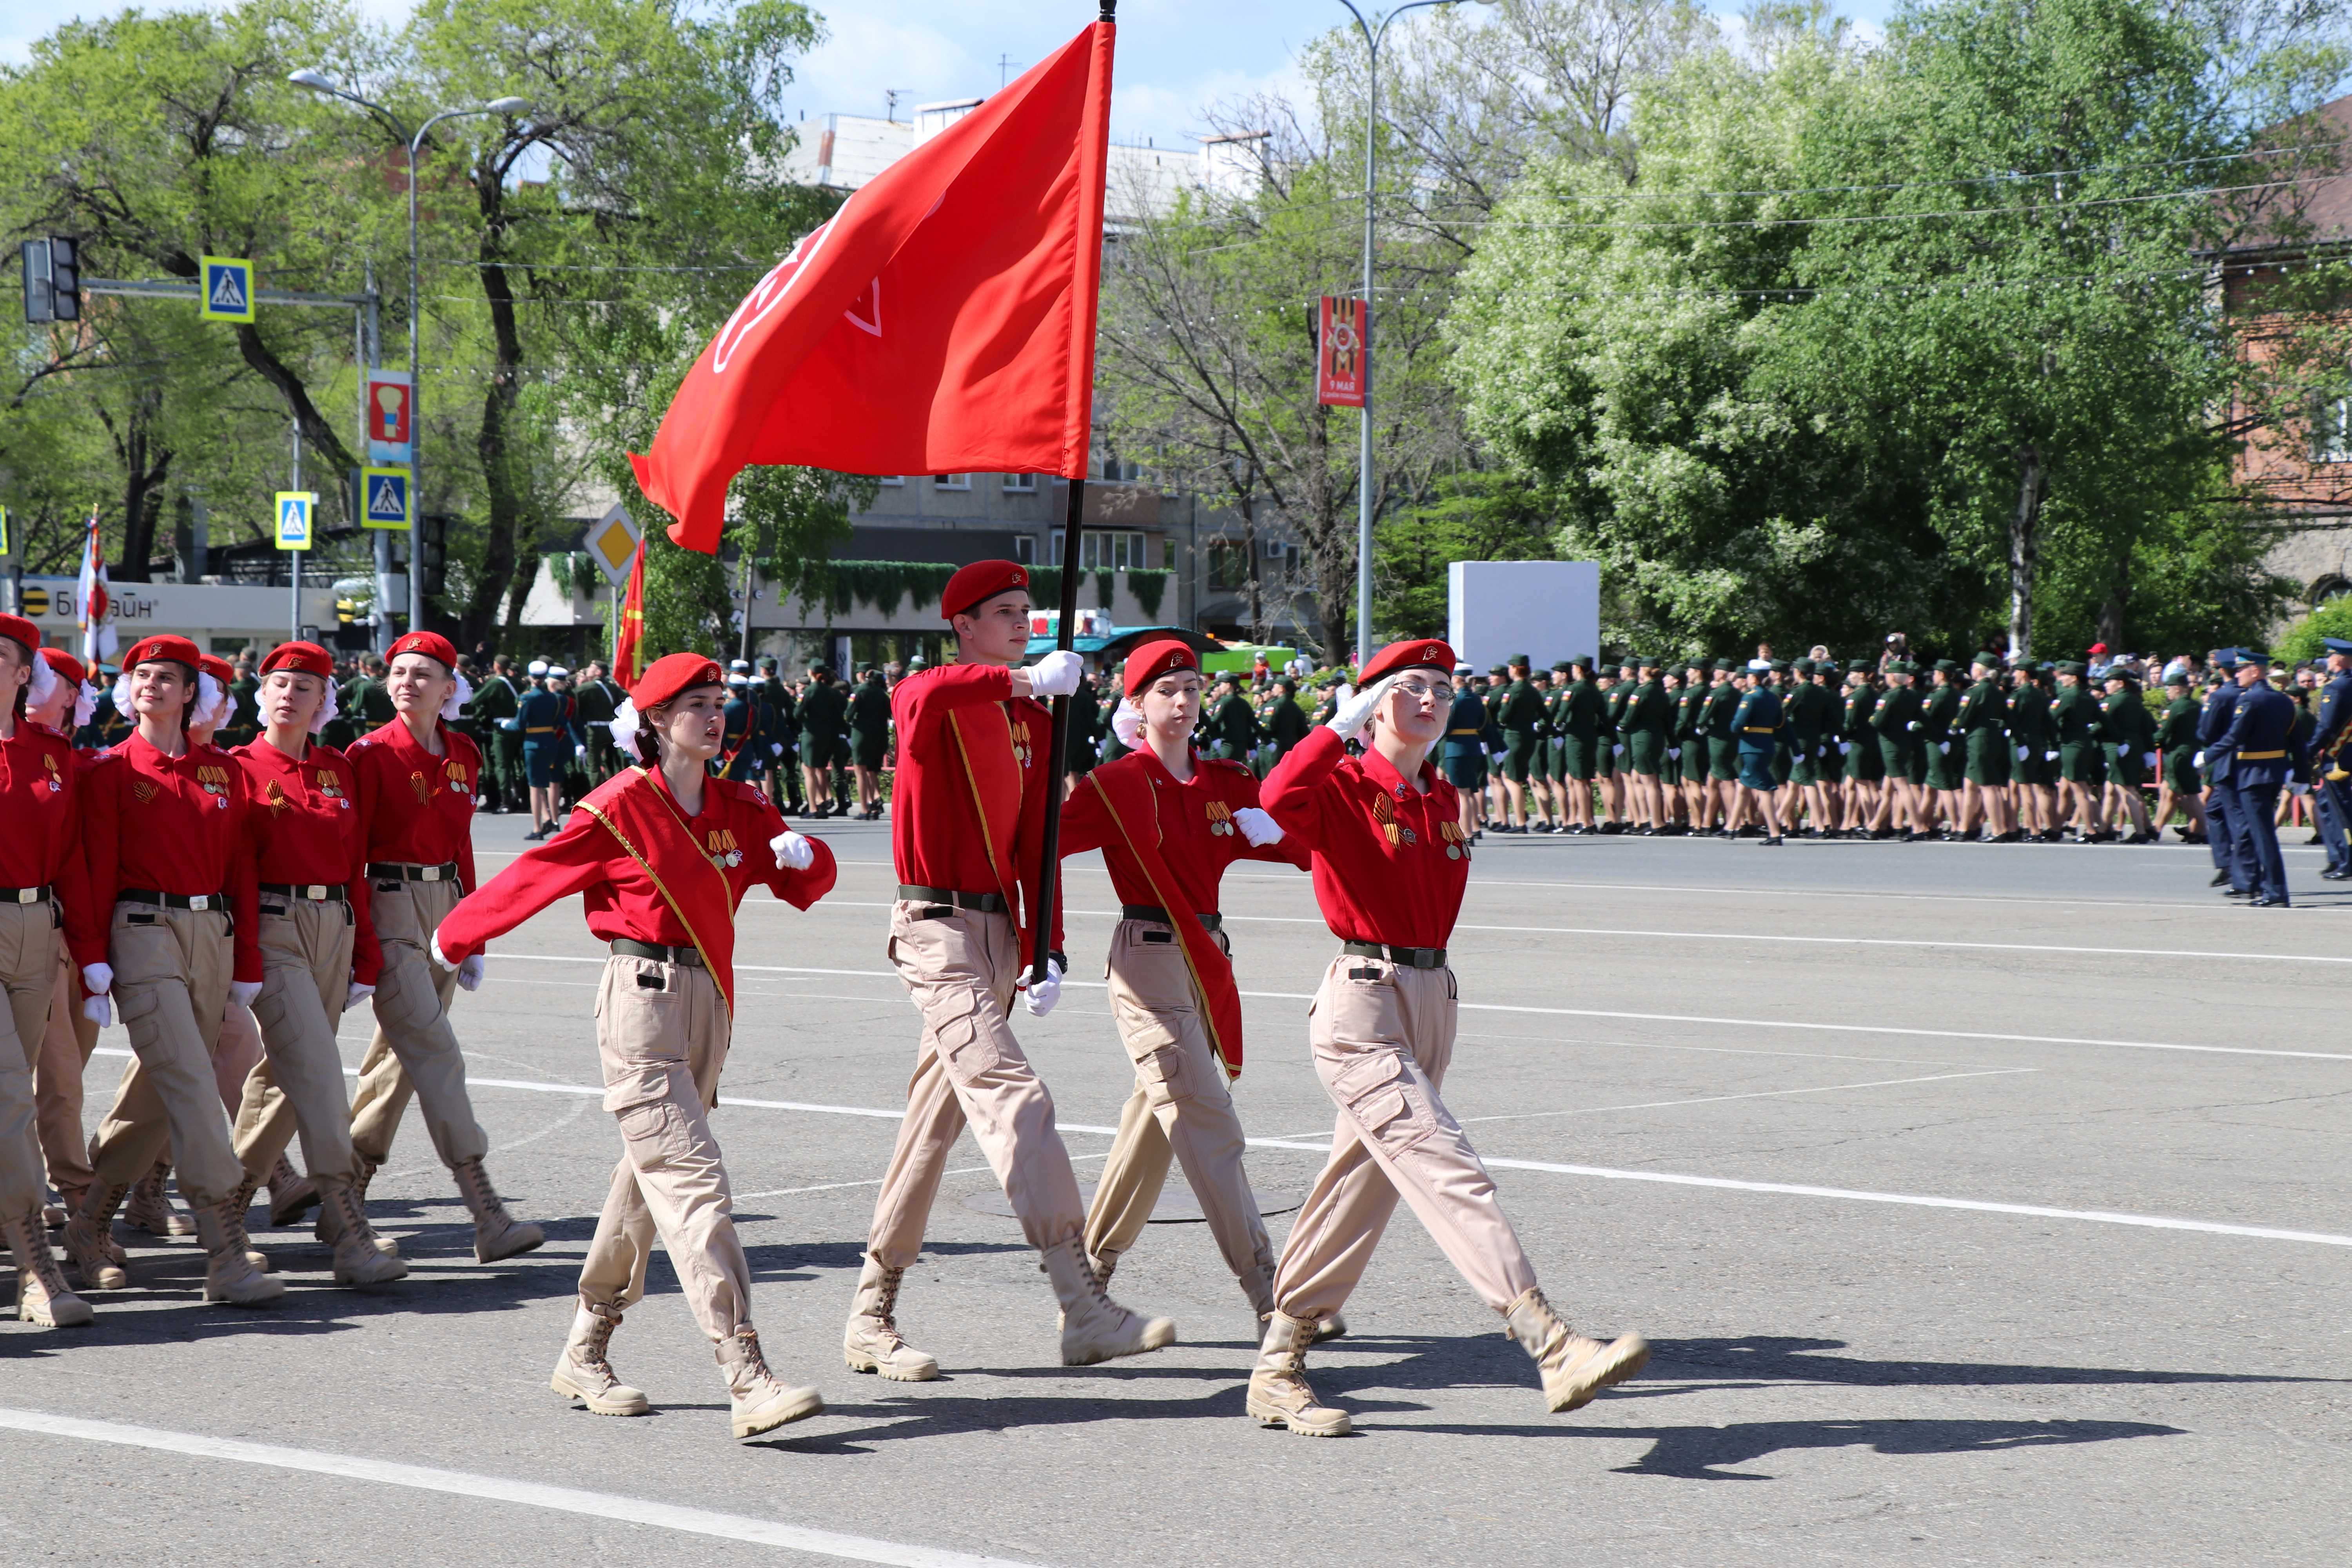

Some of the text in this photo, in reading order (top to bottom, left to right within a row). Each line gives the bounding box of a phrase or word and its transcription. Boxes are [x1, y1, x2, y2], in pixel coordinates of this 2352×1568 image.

[1330, 380, 1355, 391] 9 МАЯ
[56, 592, 151, 618] Байн
